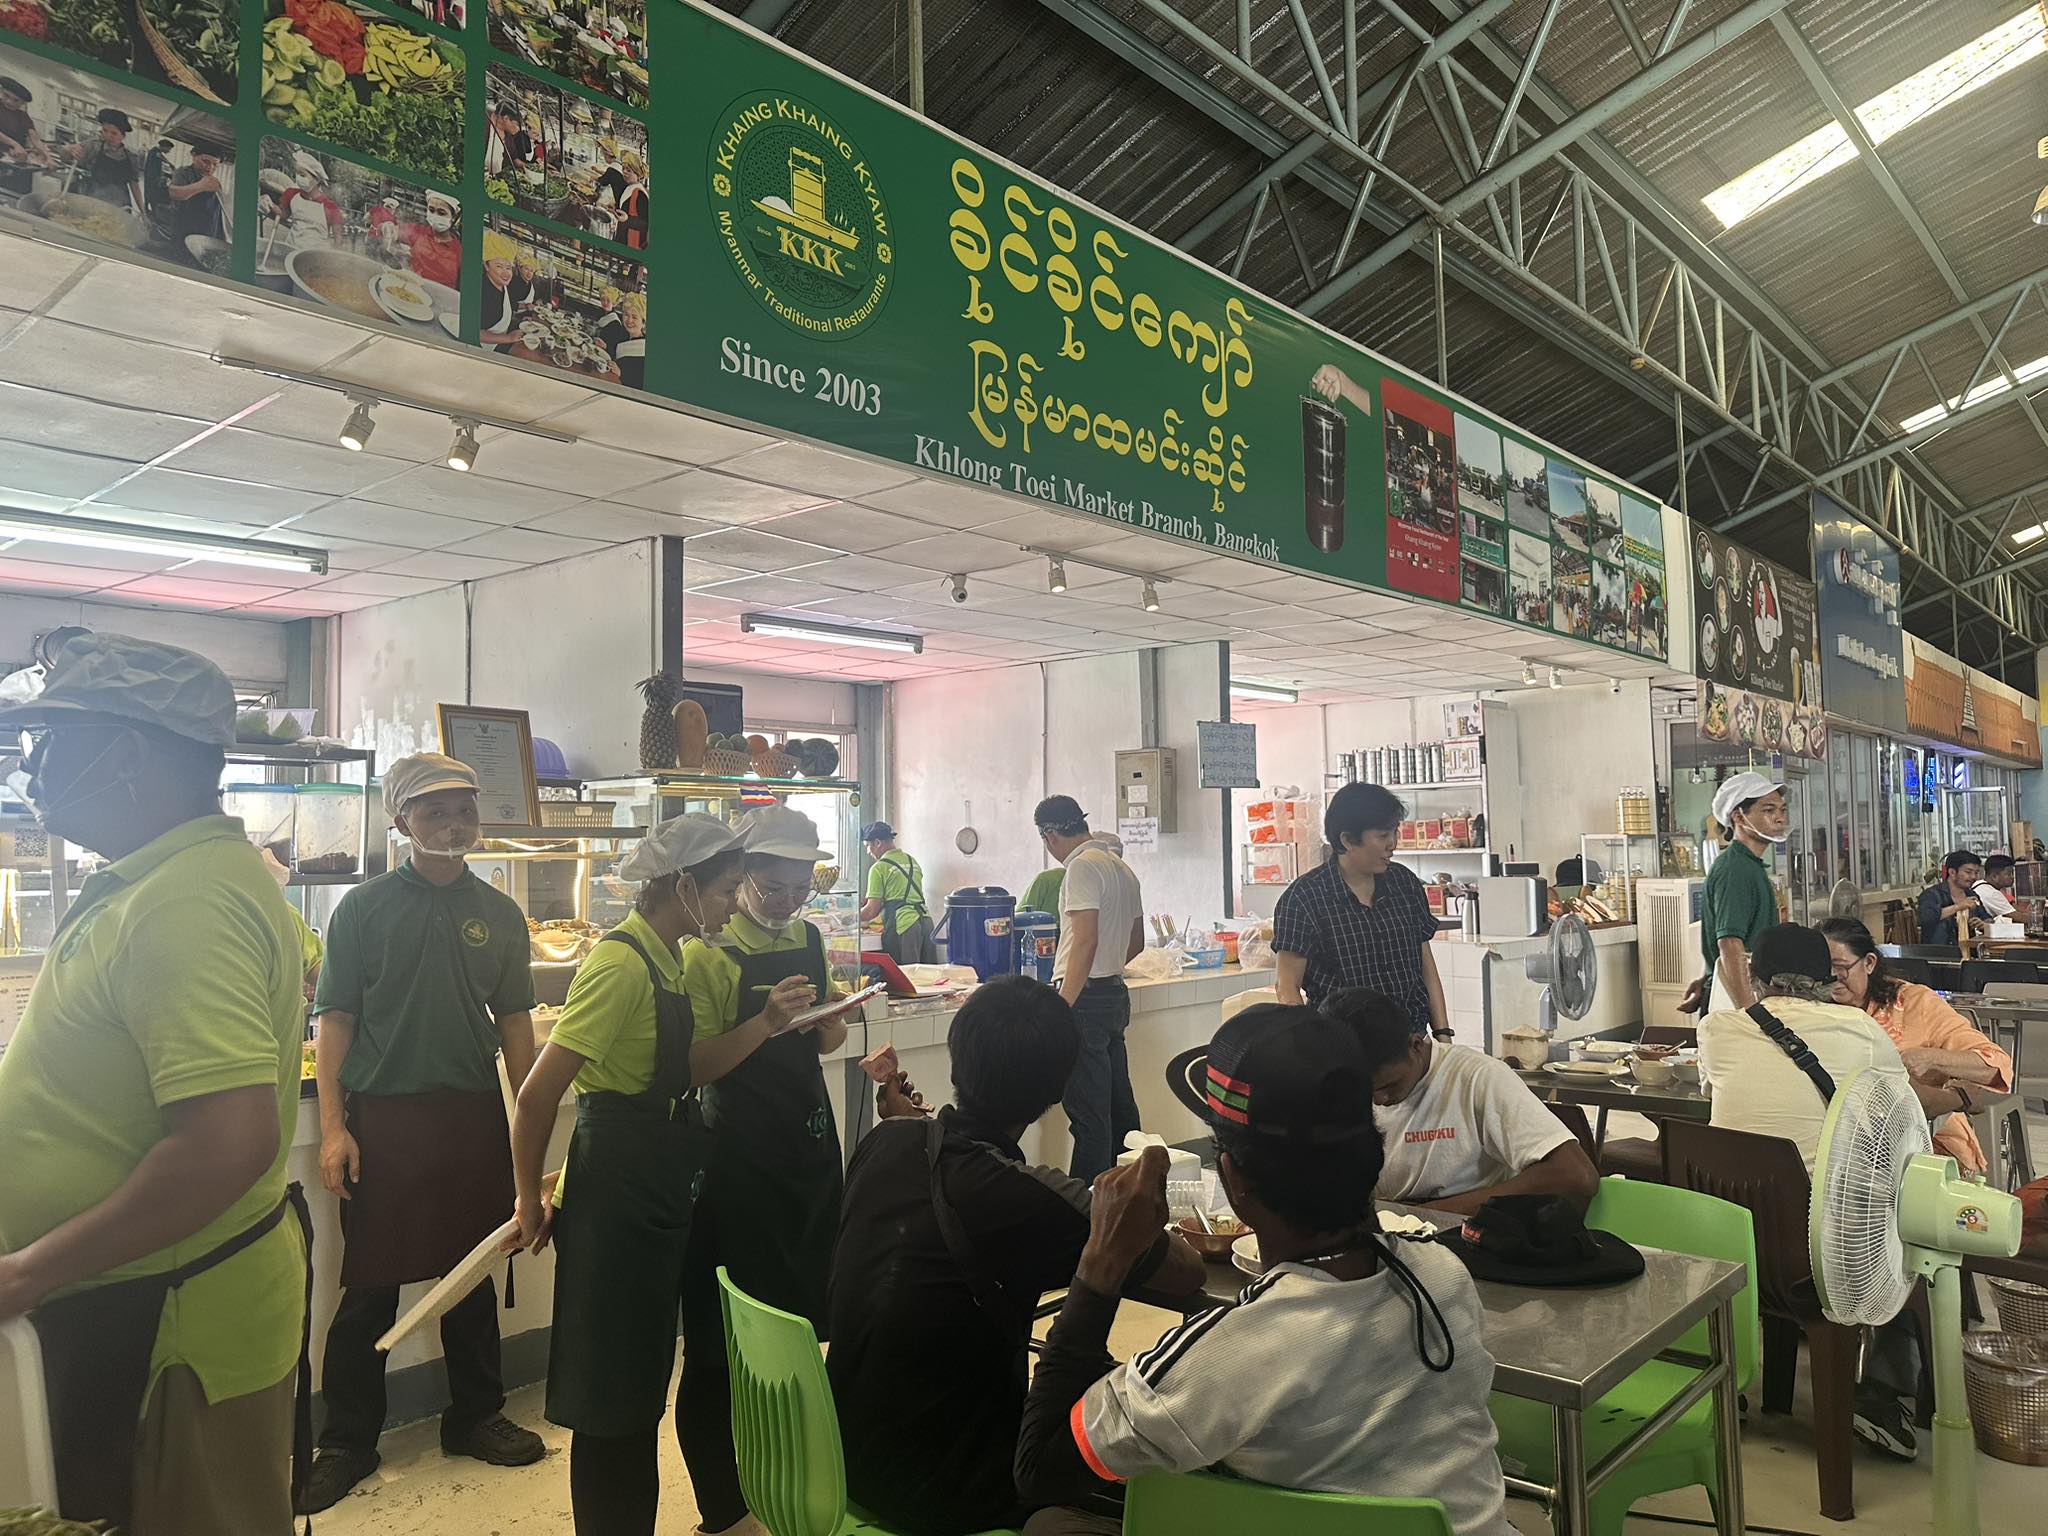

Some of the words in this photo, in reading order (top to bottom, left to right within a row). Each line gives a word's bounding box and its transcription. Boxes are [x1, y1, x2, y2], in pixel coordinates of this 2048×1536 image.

[716, 101, 773, 171] KHAING
[775, 99, 853, 158] KHAING
[853, 162, 888, 236] KYAW
[718, 210, 763, 290] Myanmar
[764, 288, 832, 333] Traditional
[835, 272, 887, 333] Restaurants
[776, 226, 844, 277] KKK
[720, 336, 806, 394] Since
[815, 367, 881, 416] 2003
[914, 434, 1002, 488] Khlong
[1010, 462, 1056, 502] Toei
[1064, 478, 1134, 523] Market
[1141, 501, 1207, 543] Branch,
[1214, 522, 1280, 562] Bangkok
